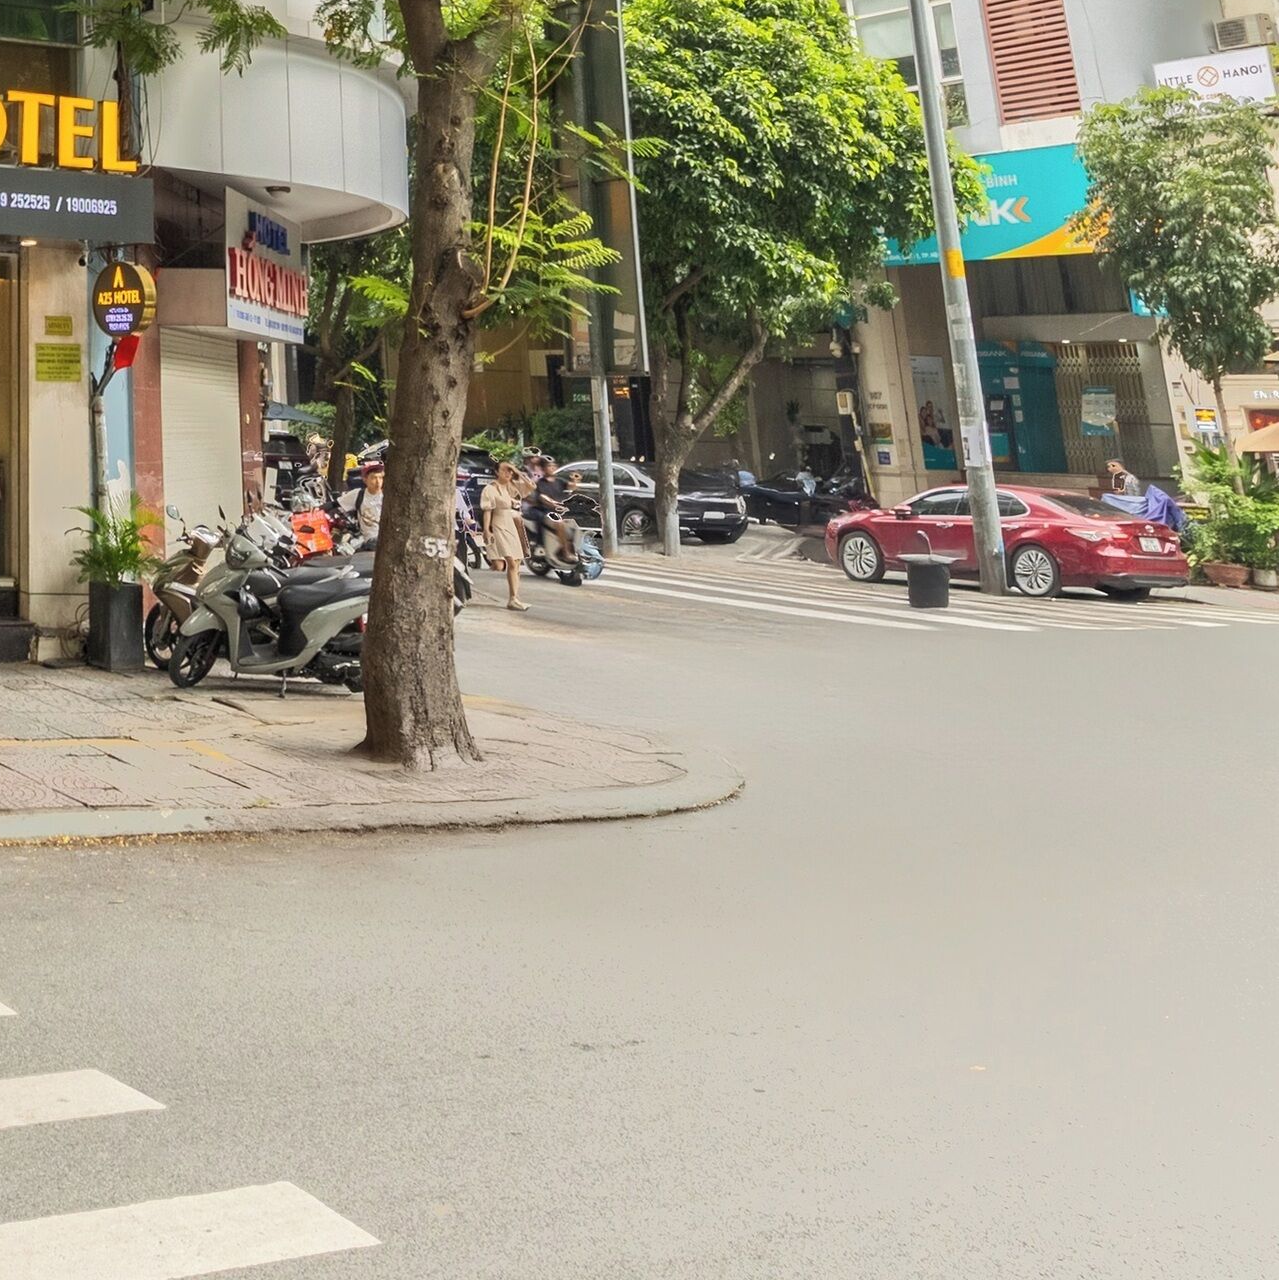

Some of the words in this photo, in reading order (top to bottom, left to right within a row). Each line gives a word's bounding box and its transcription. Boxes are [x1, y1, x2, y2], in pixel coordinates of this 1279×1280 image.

[1223, 64, 1263, 79] HANOI
[10, 192, 51, 211] 252525
[66, 196, 118, 216] 19006925
[249, 211, 290, 256] HOTEL
[97, 291, 113, 305] A25
[113, 289, 141, 305] HOTEL
[424, 536, 450, 559] 55
